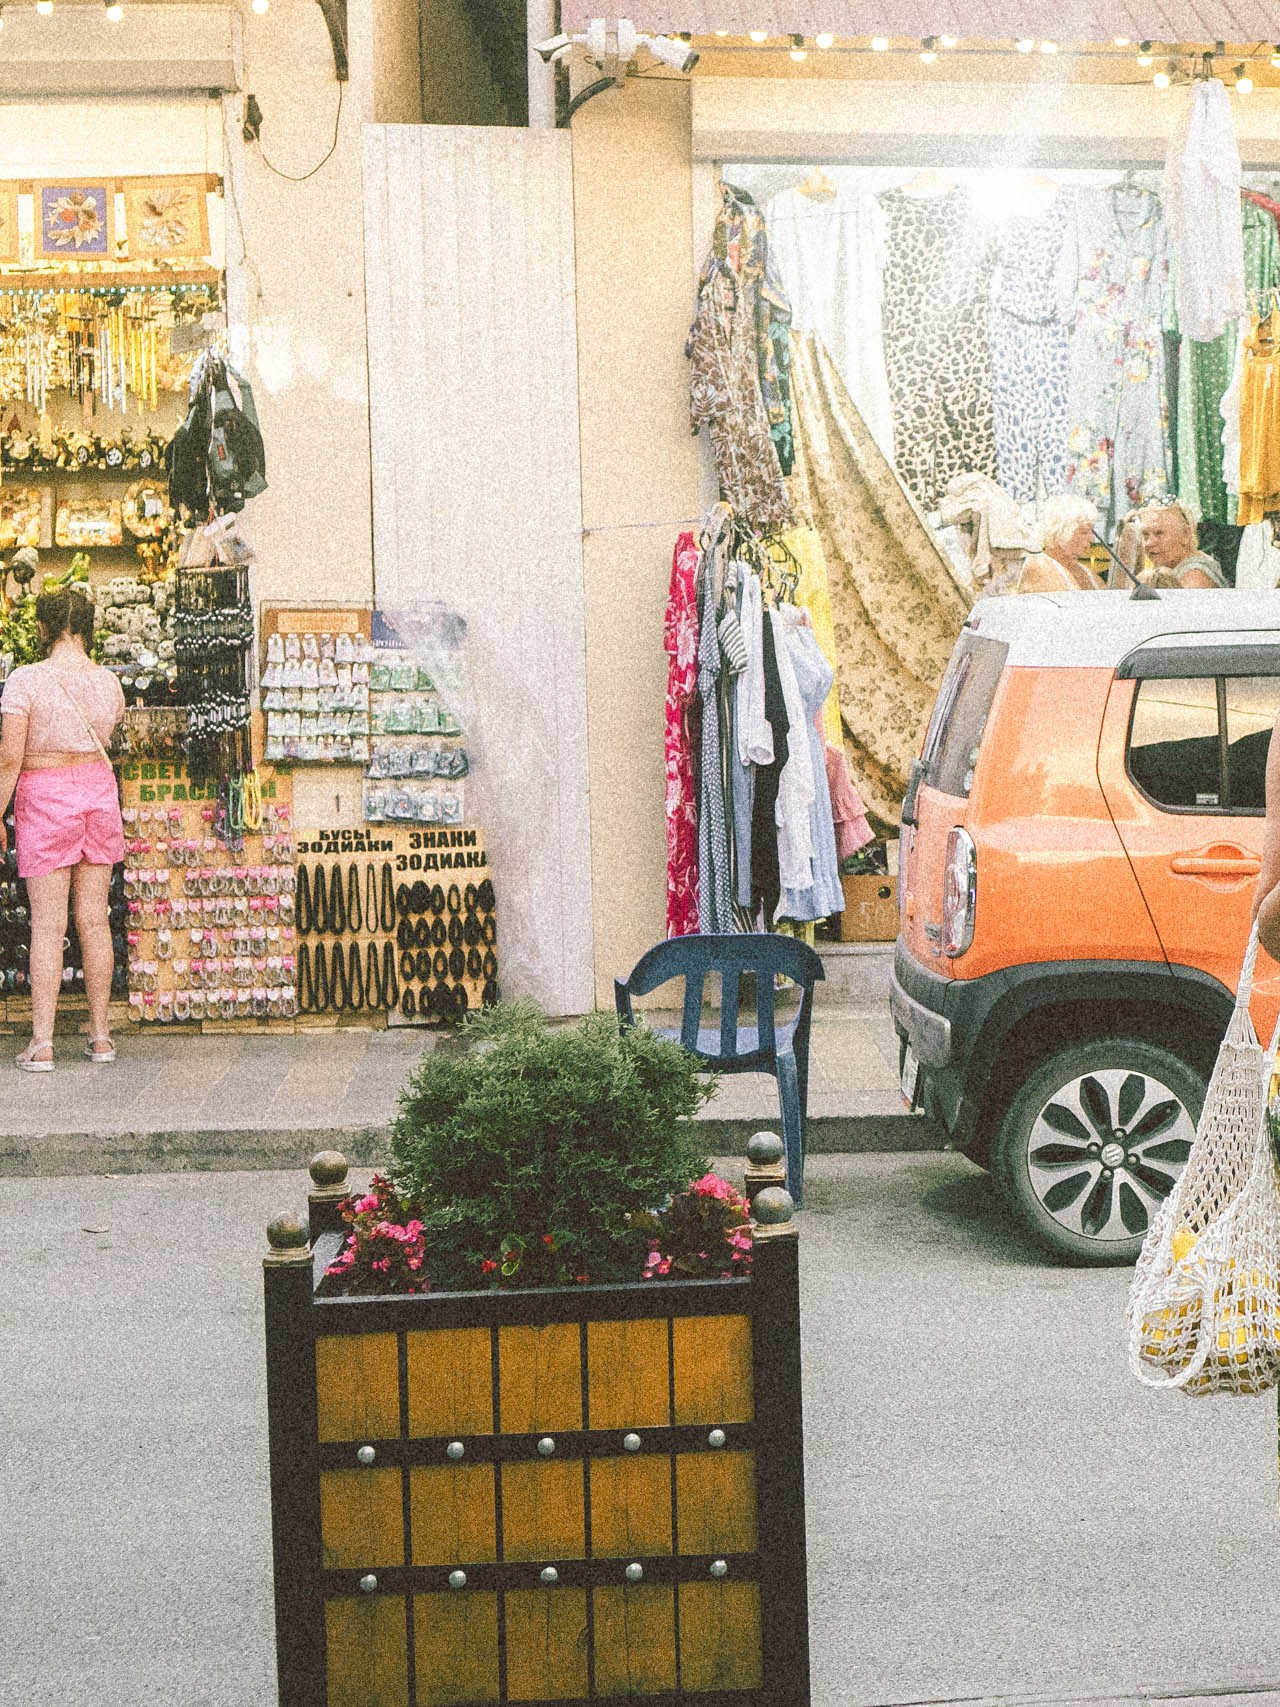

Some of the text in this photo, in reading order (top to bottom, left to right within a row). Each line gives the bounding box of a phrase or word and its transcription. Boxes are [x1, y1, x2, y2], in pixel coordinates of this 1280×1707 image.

[140, 781, 276, 800] БРАСЛЫ
[319, 829, 371, 840] БУСЫ
[409, 830, 476, 849] ЗНАКИ
[297, 840, 393, 854] ЗОДИАКИ
